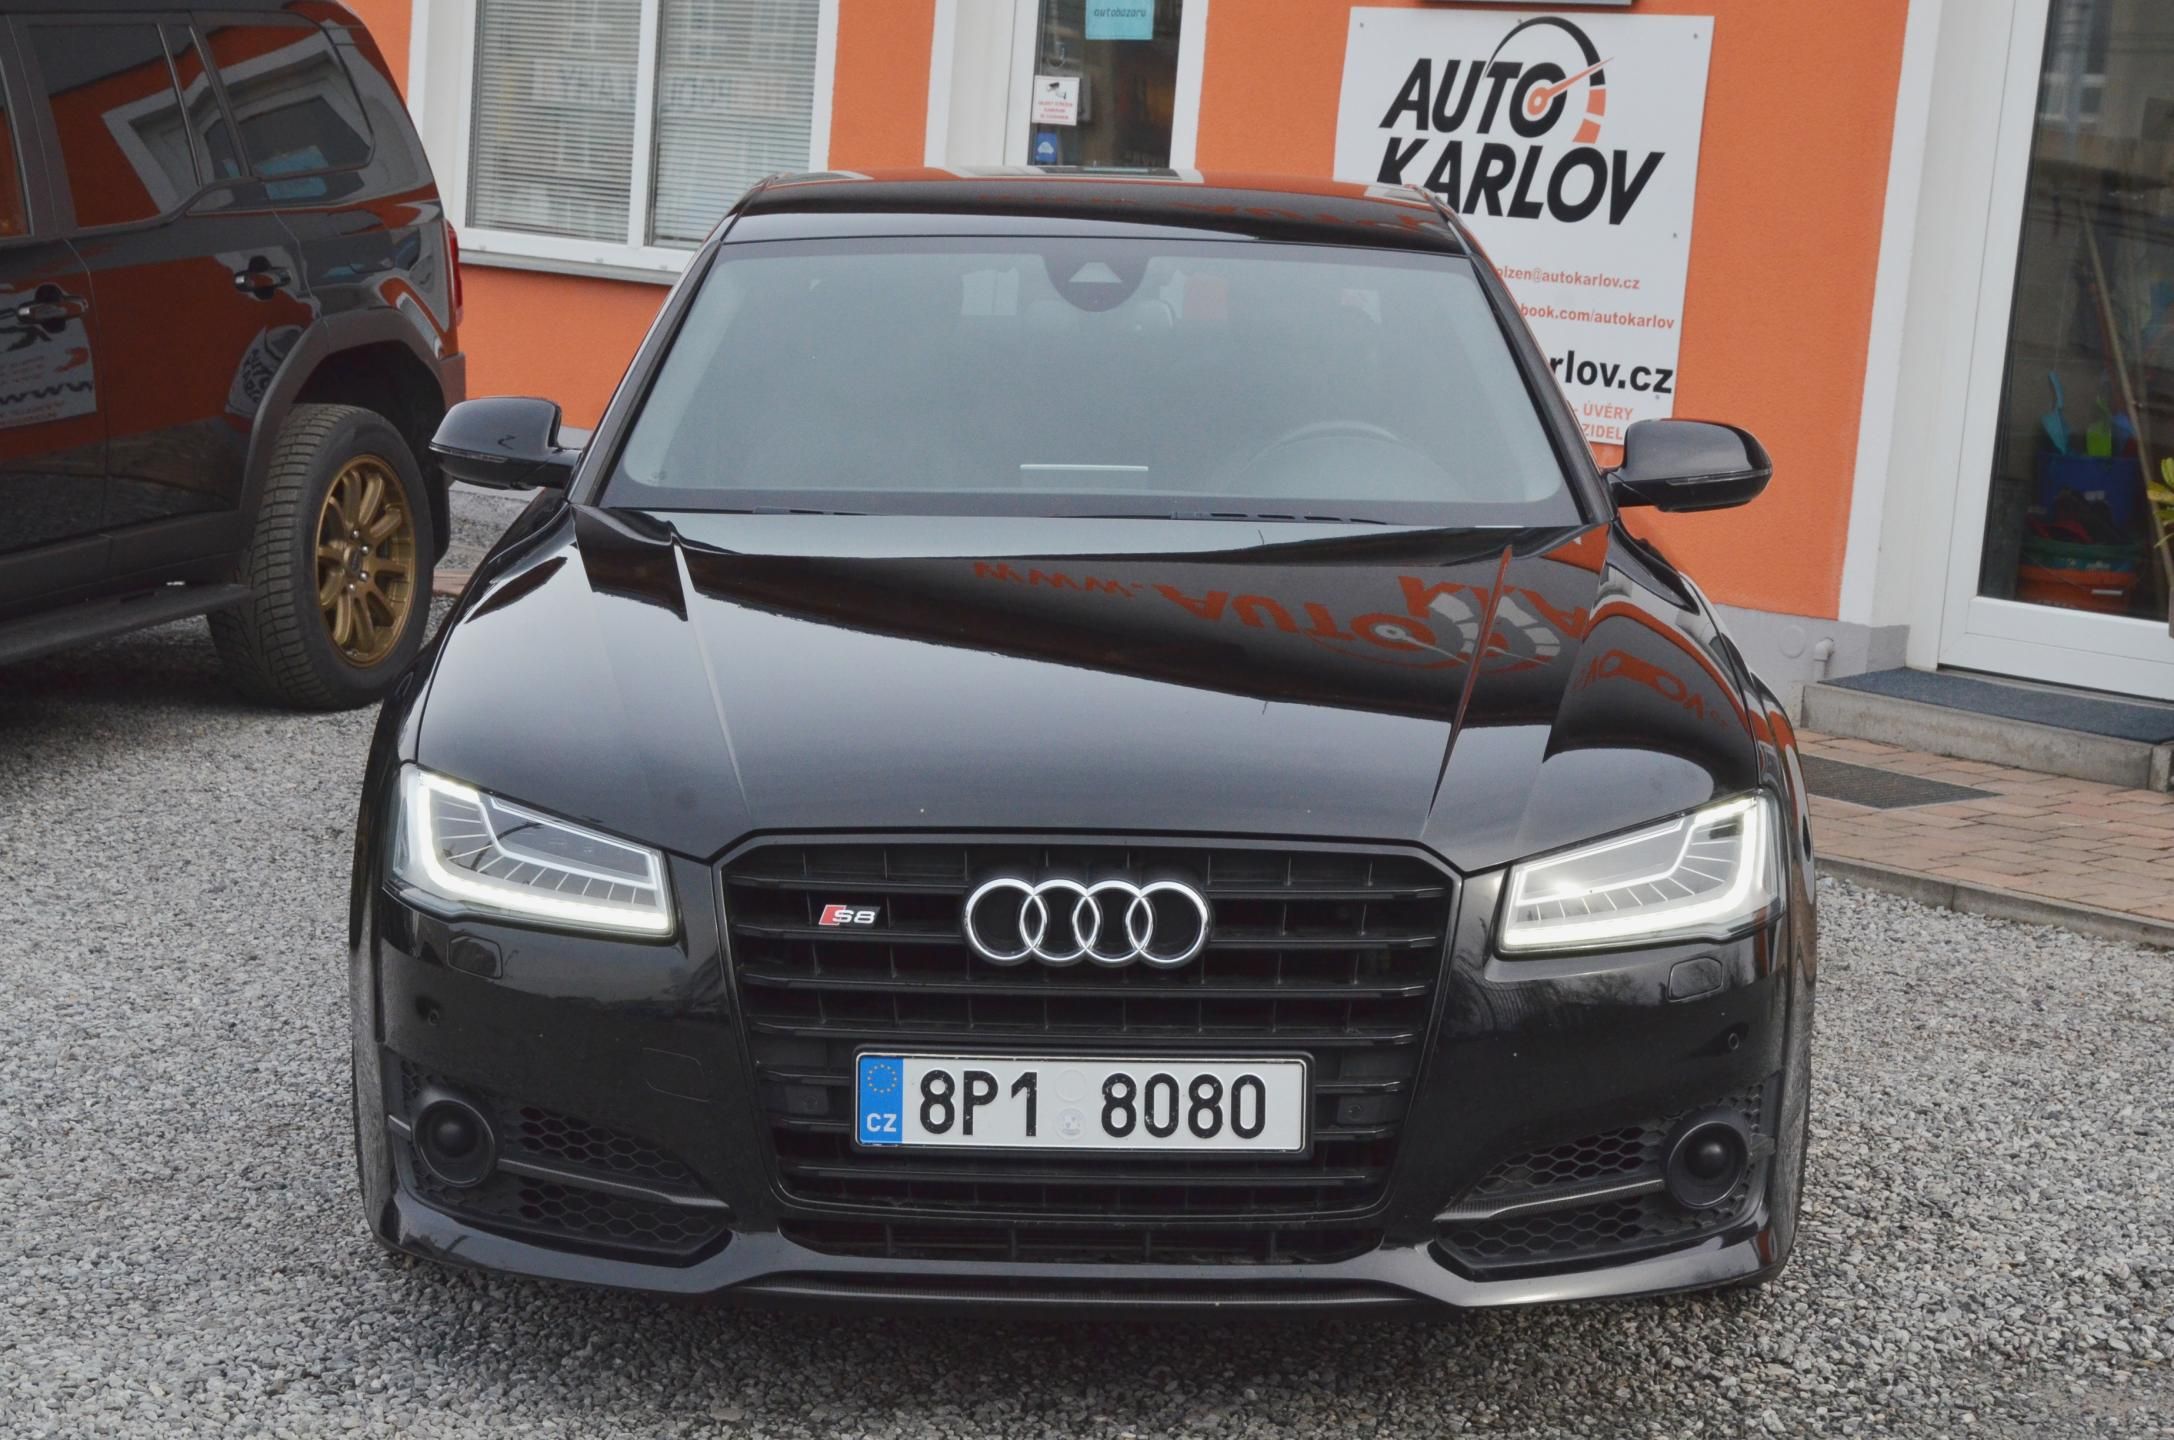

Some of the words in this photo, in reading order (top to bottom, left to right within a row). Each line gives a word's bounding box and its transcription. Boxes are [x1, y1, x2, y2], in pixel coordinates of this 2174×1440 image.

[1379, 57, 1568, 138] AUTO
[1376, 137, 1666, 226] KARLOV
[832, 909, 876, 924] S8
[866, 1112, 897, 1133] CZ
[919, 1069, 1038, 1137] 8P1
[1101, 1072, 1266, 1139] 8080
